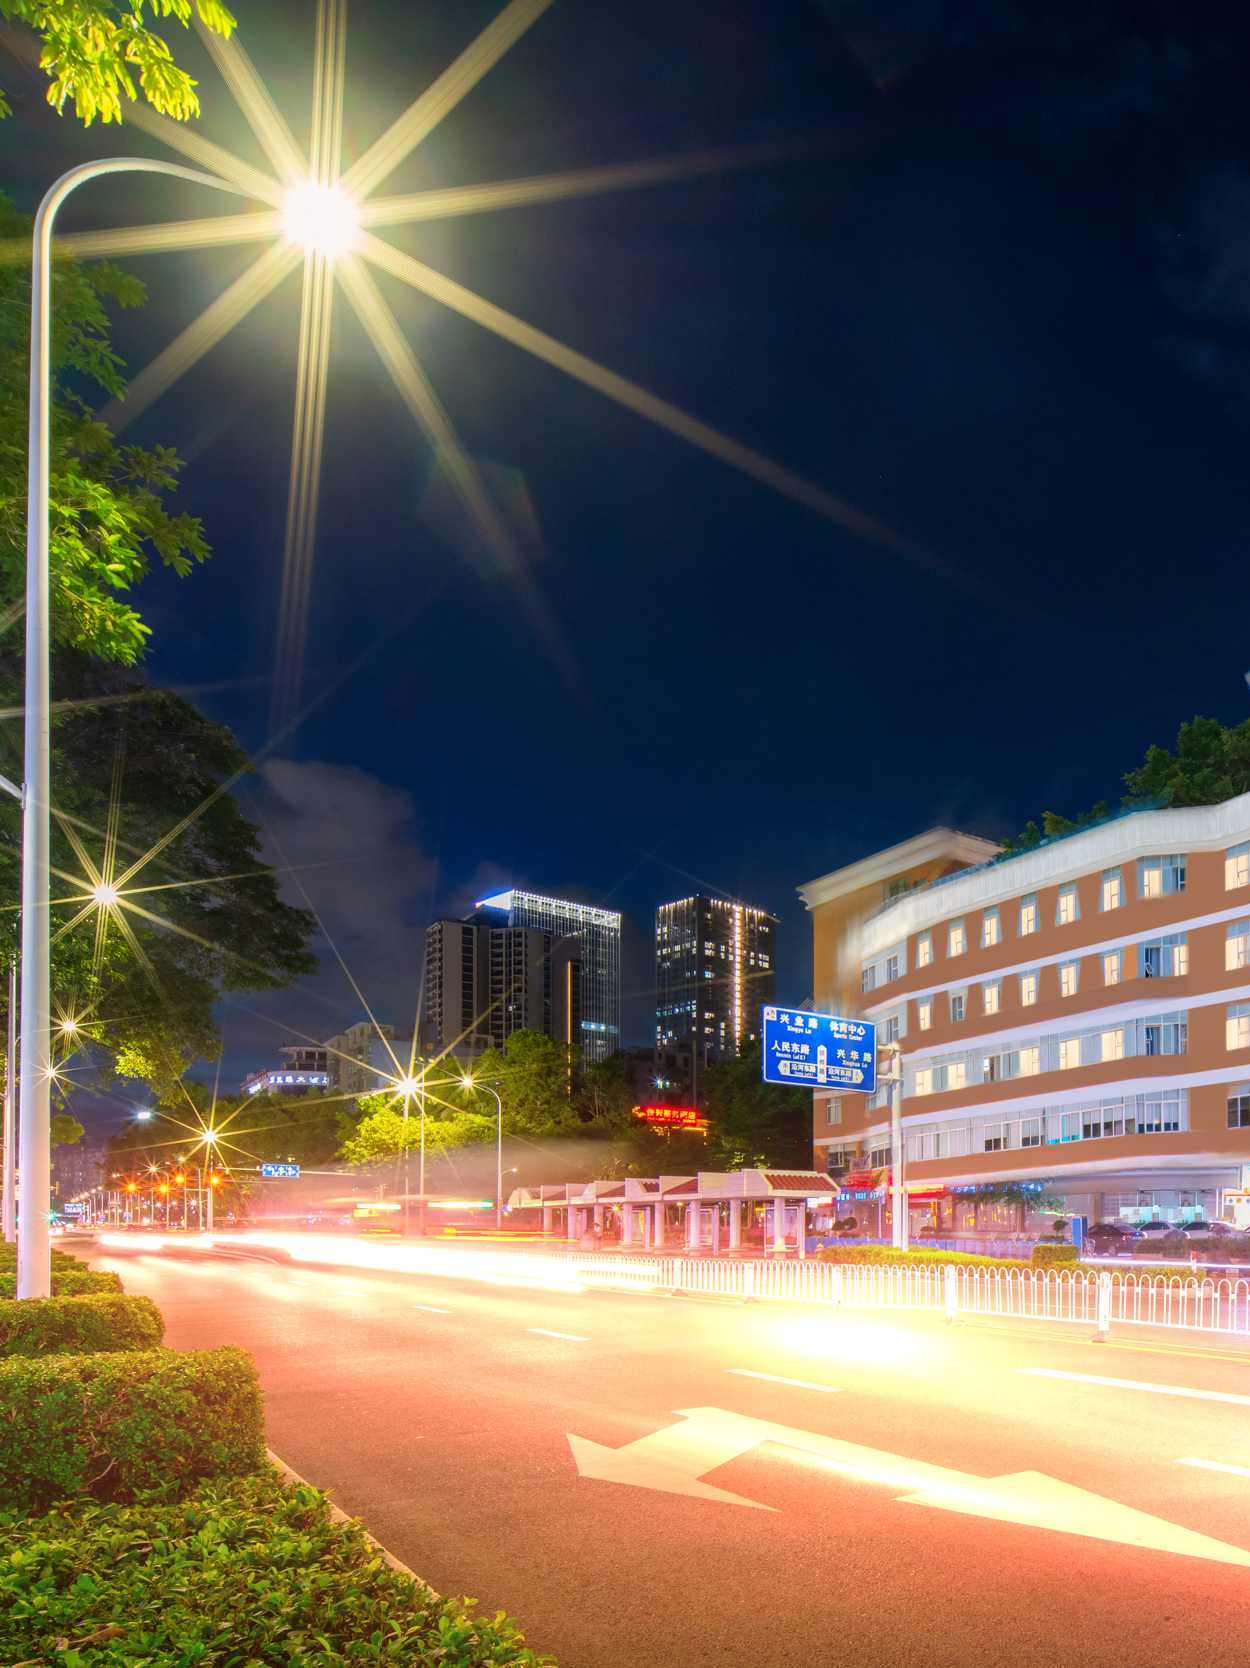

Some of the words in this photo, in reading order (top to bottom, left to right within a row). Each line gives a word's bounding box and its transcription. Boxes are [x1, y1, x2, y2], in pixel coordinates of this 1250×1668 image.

[780, 1014, 818, 1029] 兴业路
[787, 1026, 804, 1034] Xingye
[830, 1021, 866, 1036] 体育中心
[834, 1032, 848, 1040] Sports
[772, 1040, 810, 1055] 人民东路
[837, 1049, 872, 1063] 兴华路
[791, 1063, 816, 1073] 沿河东路
[842, 1060, 860, 1068] Xinghua
[828, 1068, 852, 1078] 沿河东路
